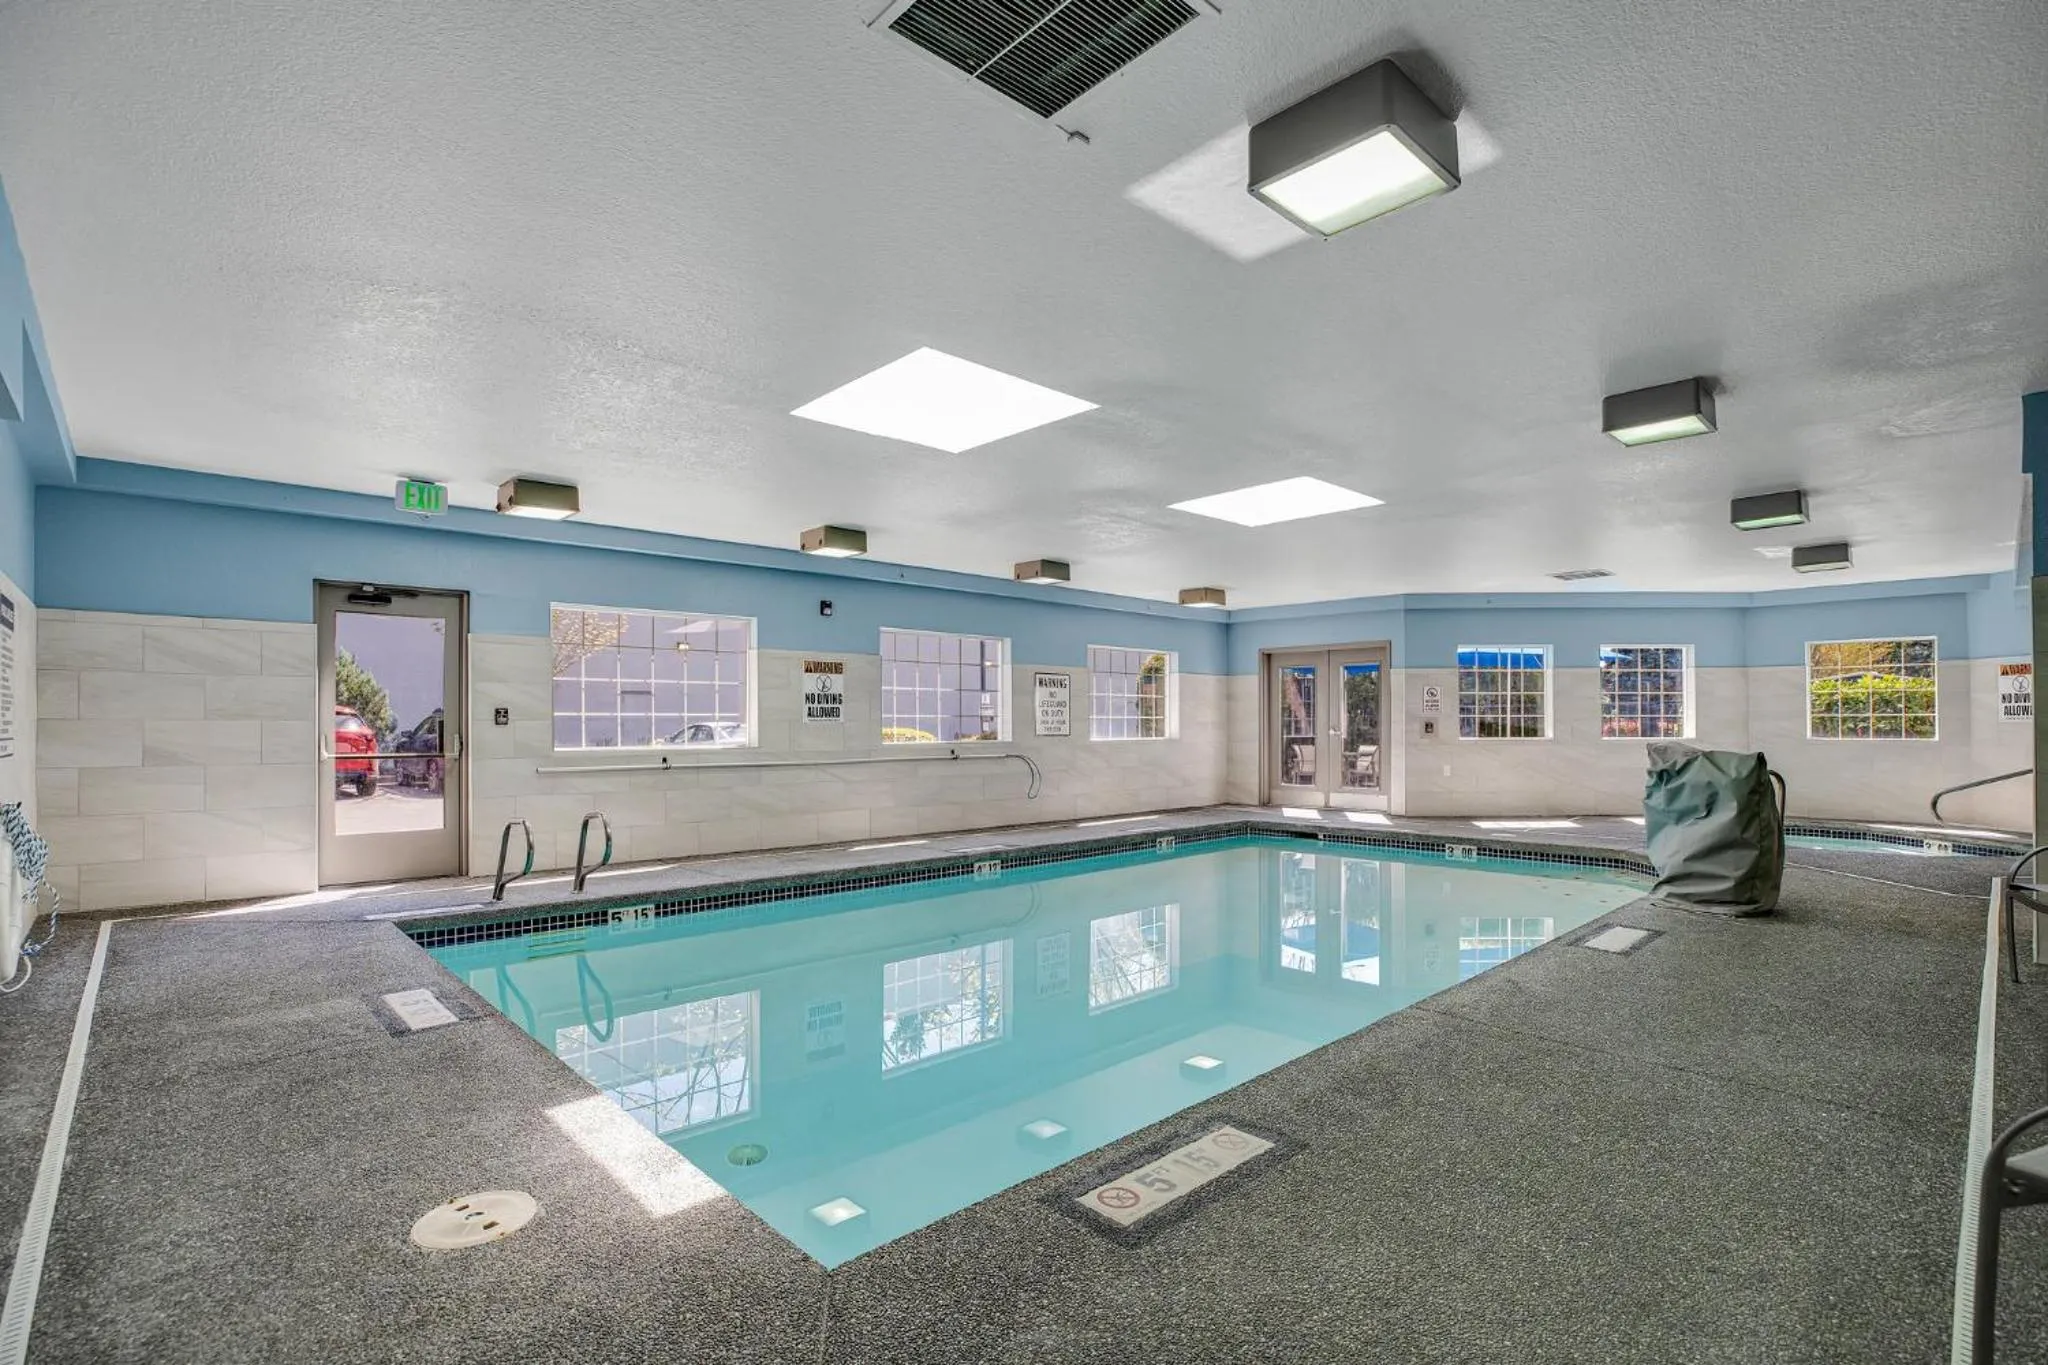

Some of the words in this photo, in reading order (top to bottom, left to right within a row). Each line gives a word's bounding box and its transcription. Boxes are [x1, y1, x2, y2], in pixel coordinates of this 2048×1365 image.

[405, 482, 444, 511] EXIT
[812, 661, 843, 674] WARNING
[2009, 663, 2032, 675] WARN
[1039, 677, 1067, 688] WARNING
[805, 693, 815, 705] NO
[817, 693, 843, 705] DIVING
[2001, 693, 2012, 704] NO
[807, 706, 841, 718] ALLOWED
